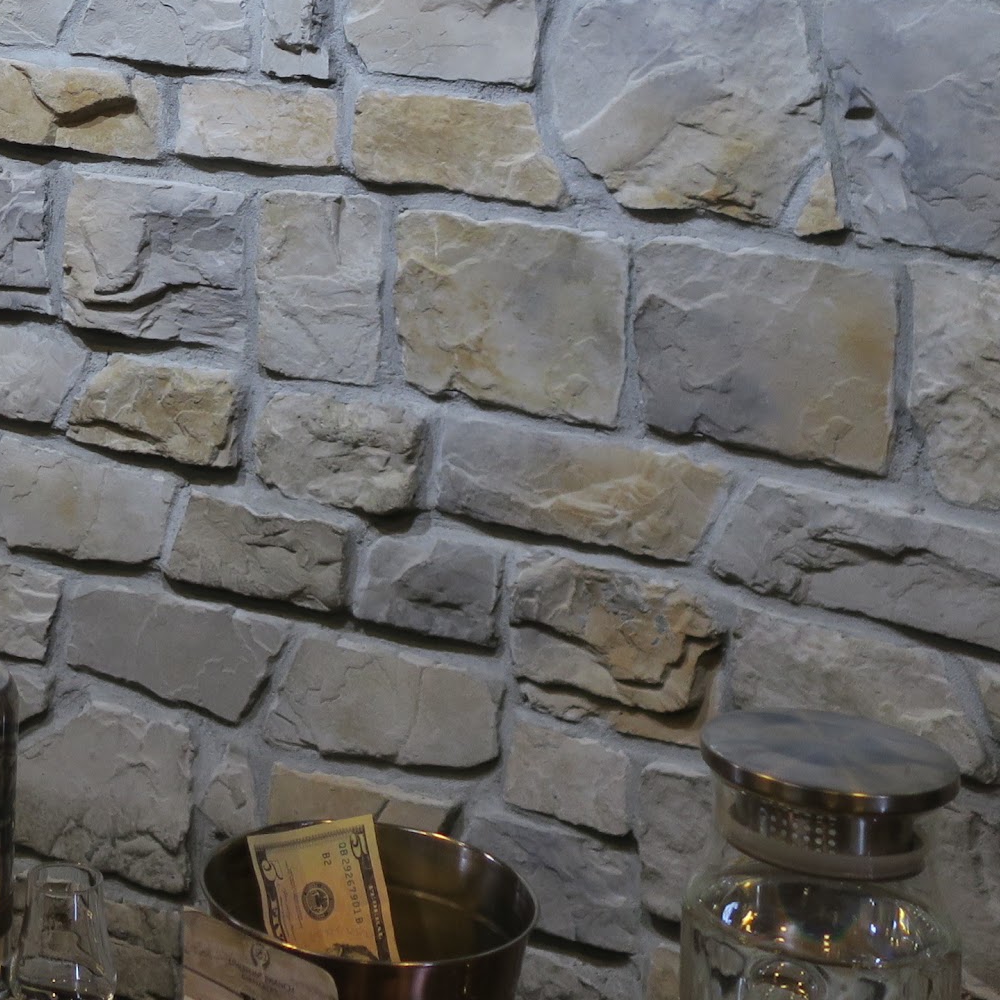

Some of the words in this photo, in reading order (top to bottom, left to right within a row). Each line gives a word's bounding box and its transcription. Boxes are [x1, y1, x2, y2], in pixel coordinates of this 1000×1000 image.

[350, 832, 369, 859] 5
[261, 858, 284, 882] 5
[321, 852, 332, 867] B2
